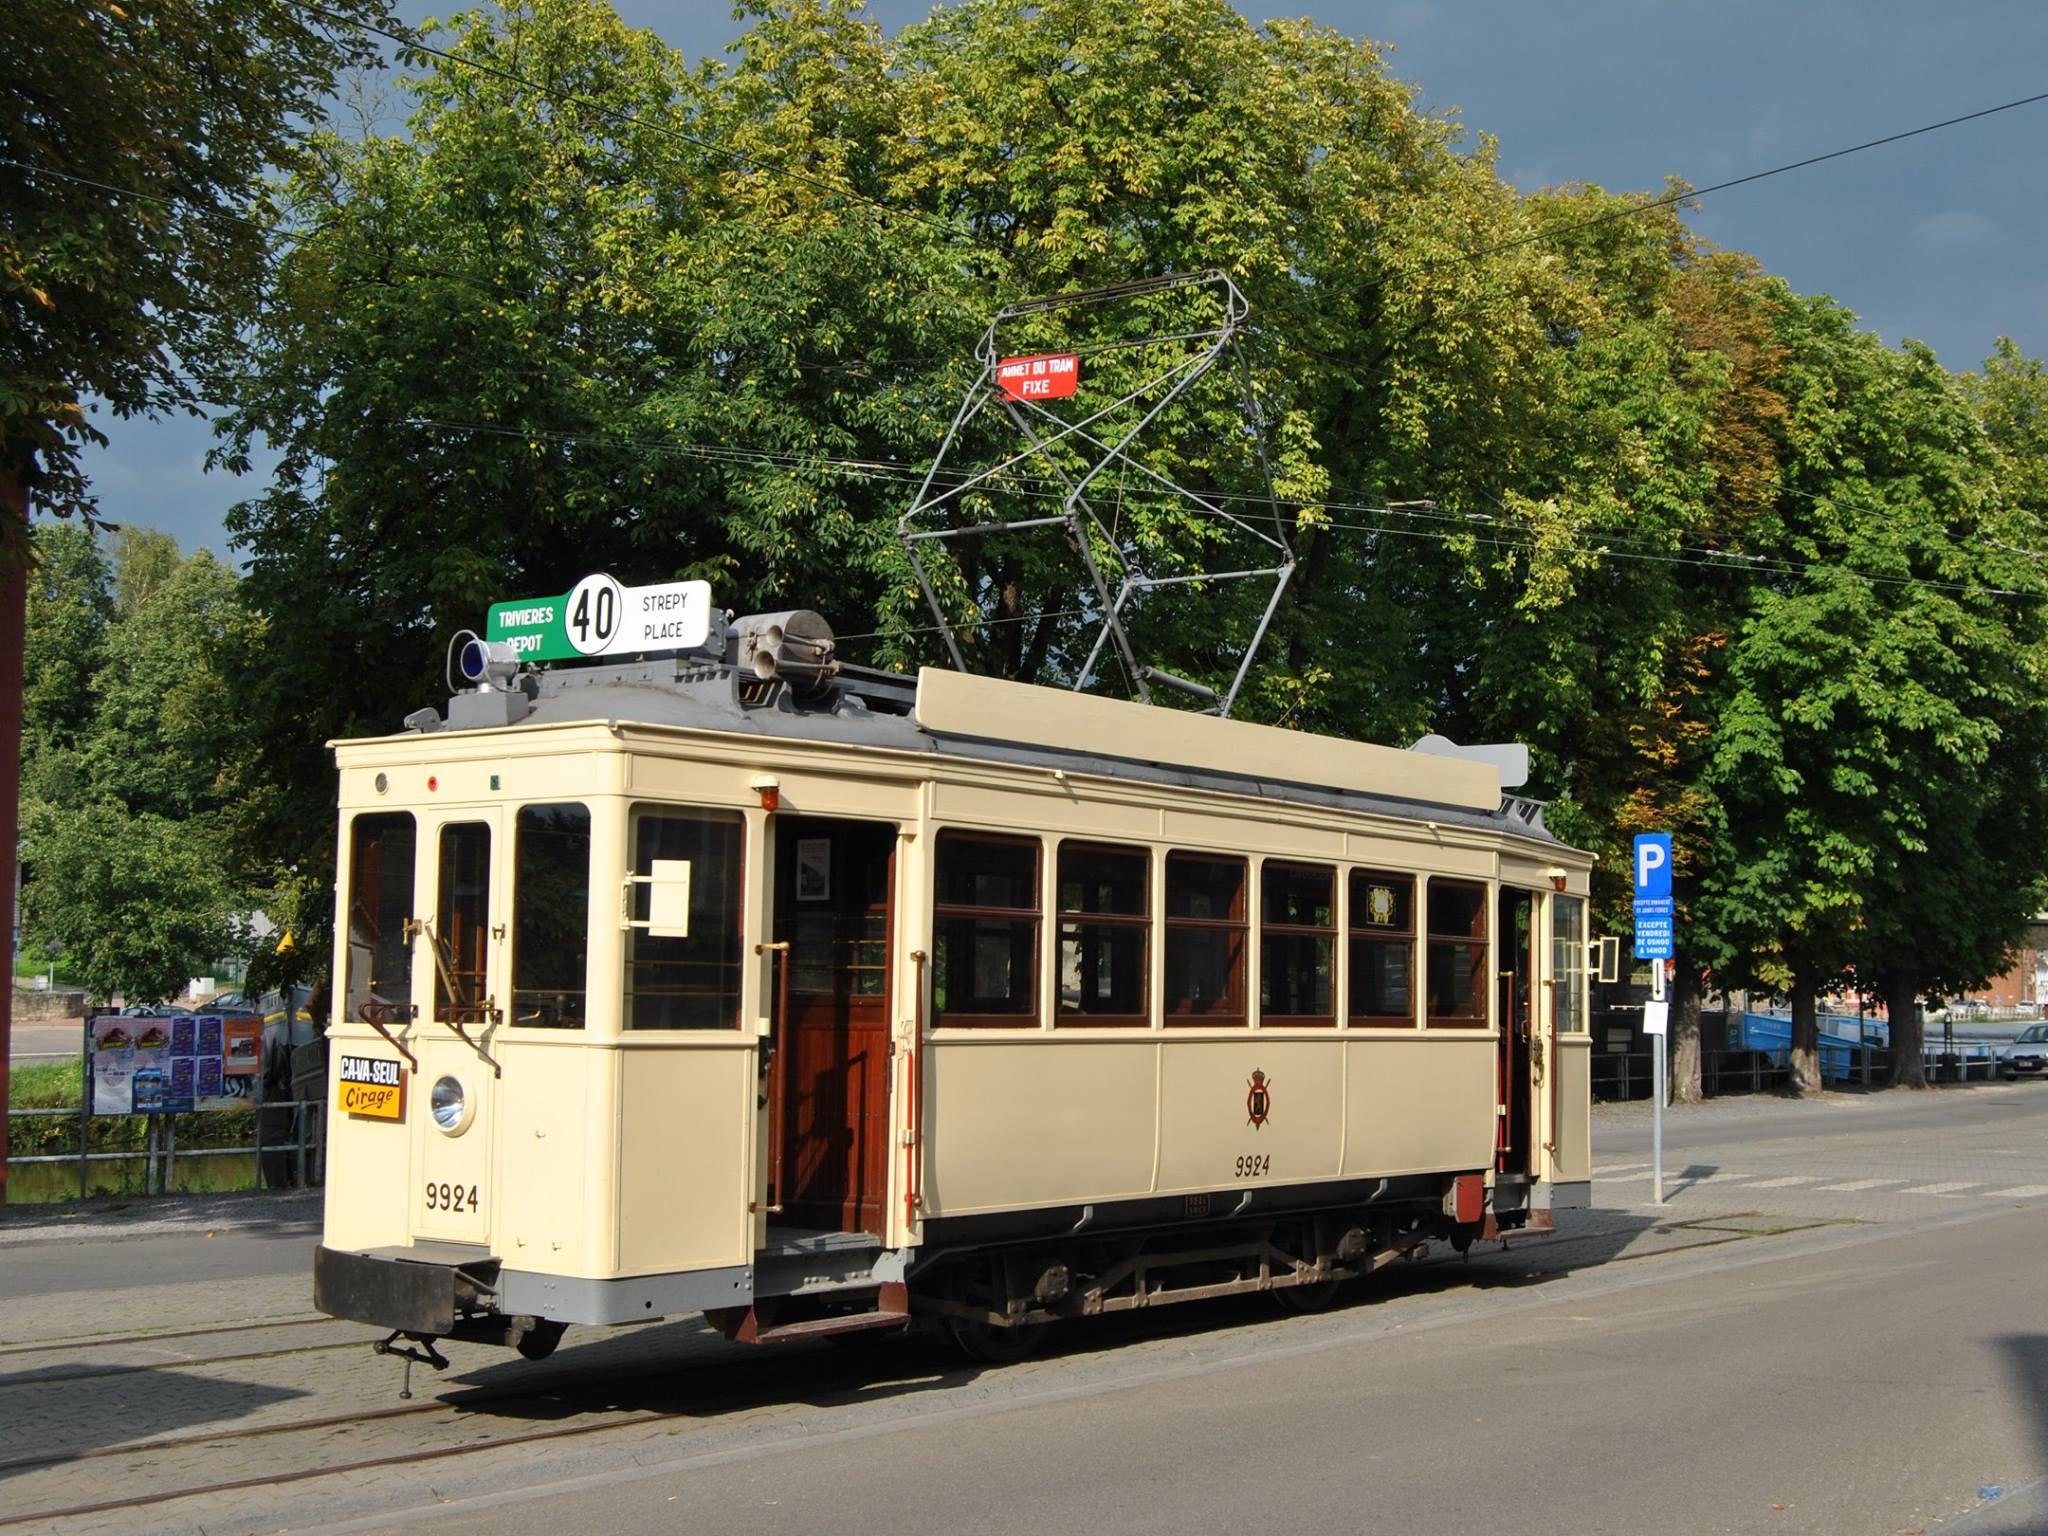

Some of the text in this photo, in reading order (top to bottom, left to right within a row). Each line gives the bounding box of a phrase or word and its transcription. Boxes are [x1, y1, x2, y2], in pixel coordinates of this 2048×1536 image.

[1032, 361, 1046, 375] DU
[1048, 359, 1074, 374] TRAM
[1022, 379, 1050, 395] FIXE
[642, 592, 688, 612] STREPY
[499, 606, 554, 628] TRIVIERES
[572, 586, 614, 642] 40
[644, 621, 683, 640] PLACE
[506, 634, 543, 653] DEPOT
[1639, 843, 1665, 887] P
[1638, 921, 1668, 929] EXCEPTE
[1639, 946, 1646, 954] A
[346, 1087, 394, 1110] Cirage
[1235, 1154, 1271, 1177] 9924
[426, 1182, 478, 1213] 9924
